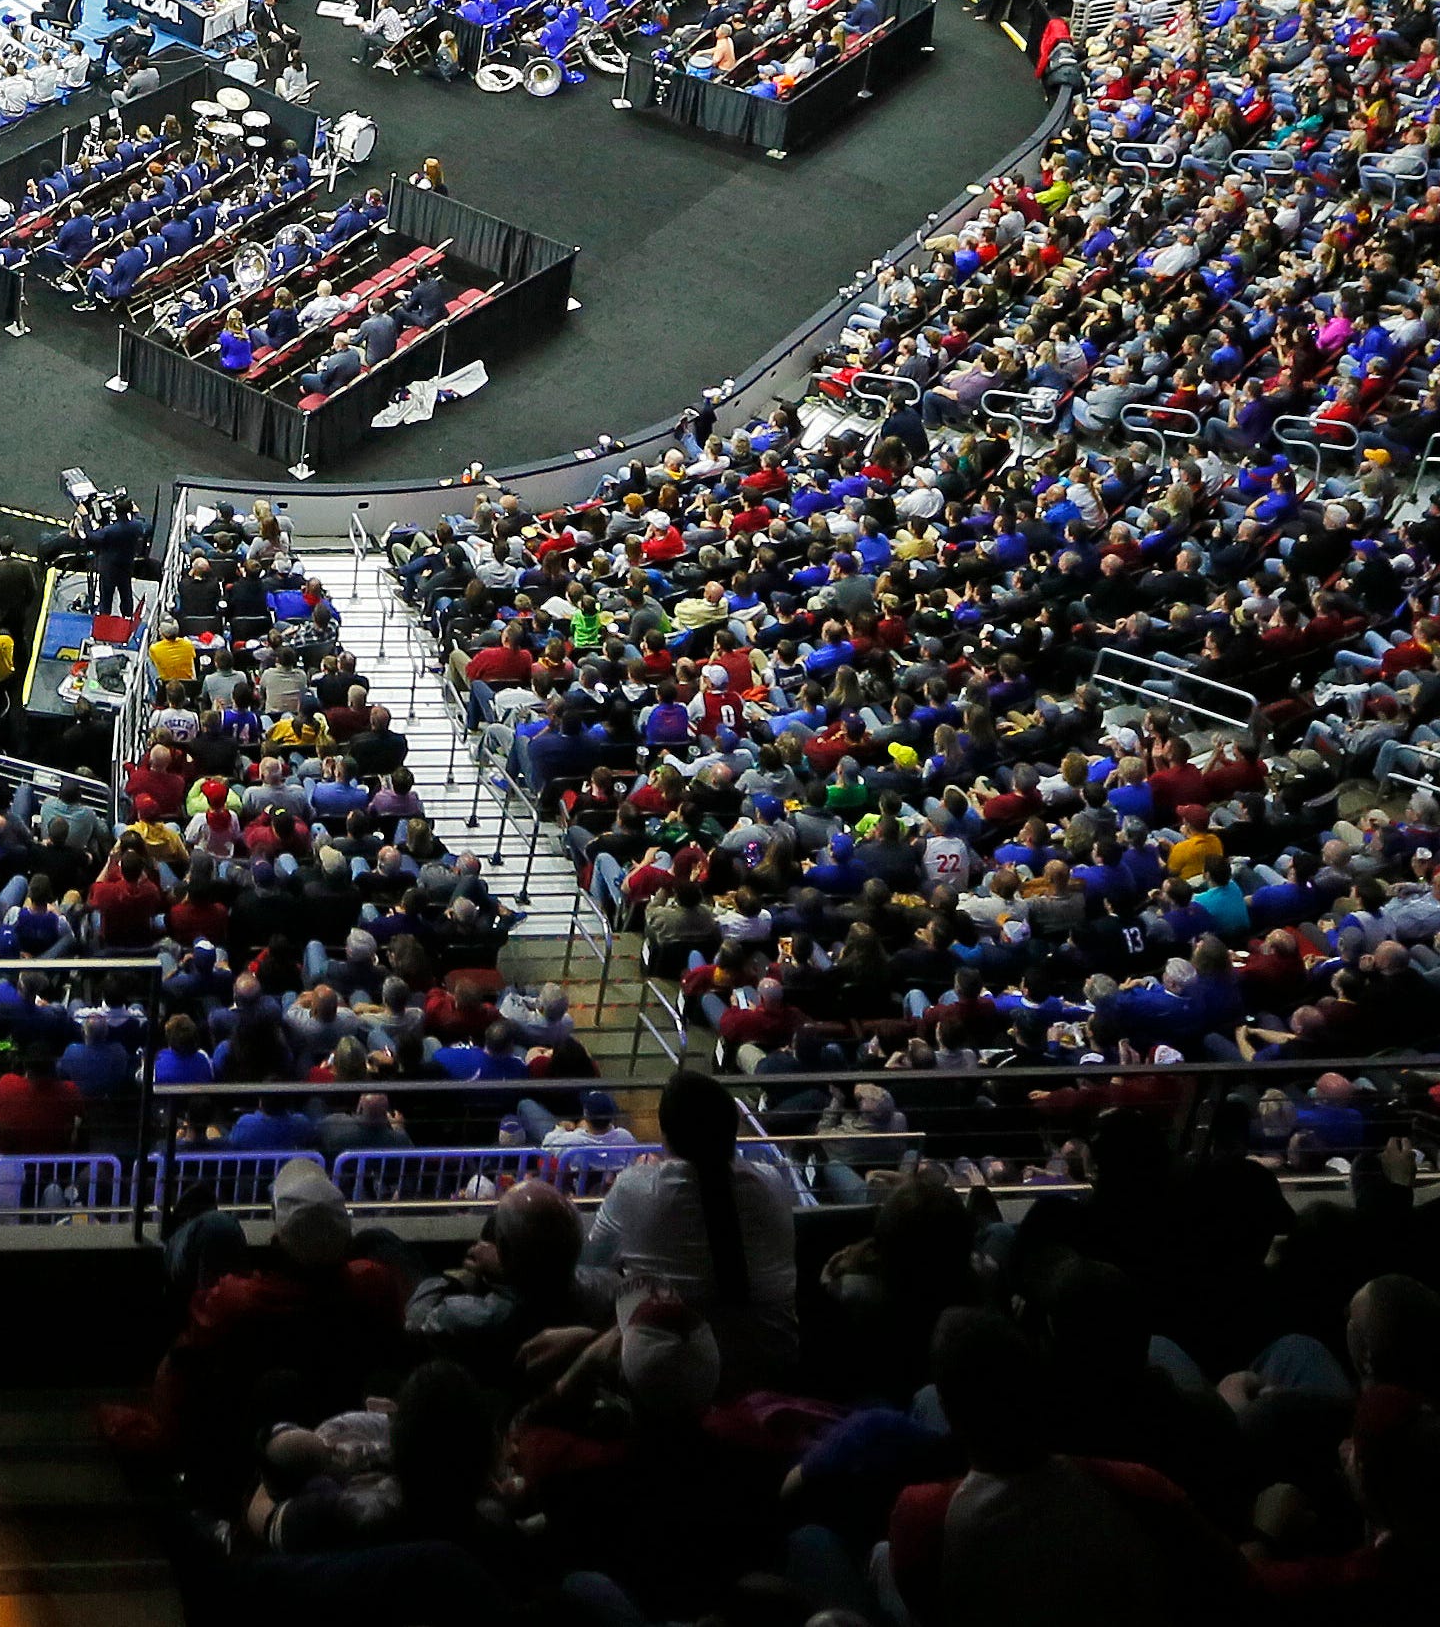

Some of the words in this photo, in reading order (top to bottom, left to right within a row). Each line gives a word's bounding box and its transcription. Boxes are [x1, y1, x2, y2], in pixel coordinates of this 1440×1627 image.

[30, 29, 65, 49] CATS
[3, 43, 35, 61] CATS
[936, 854, 960, 874] 22
[1123, 927, 1145, 954] 13
